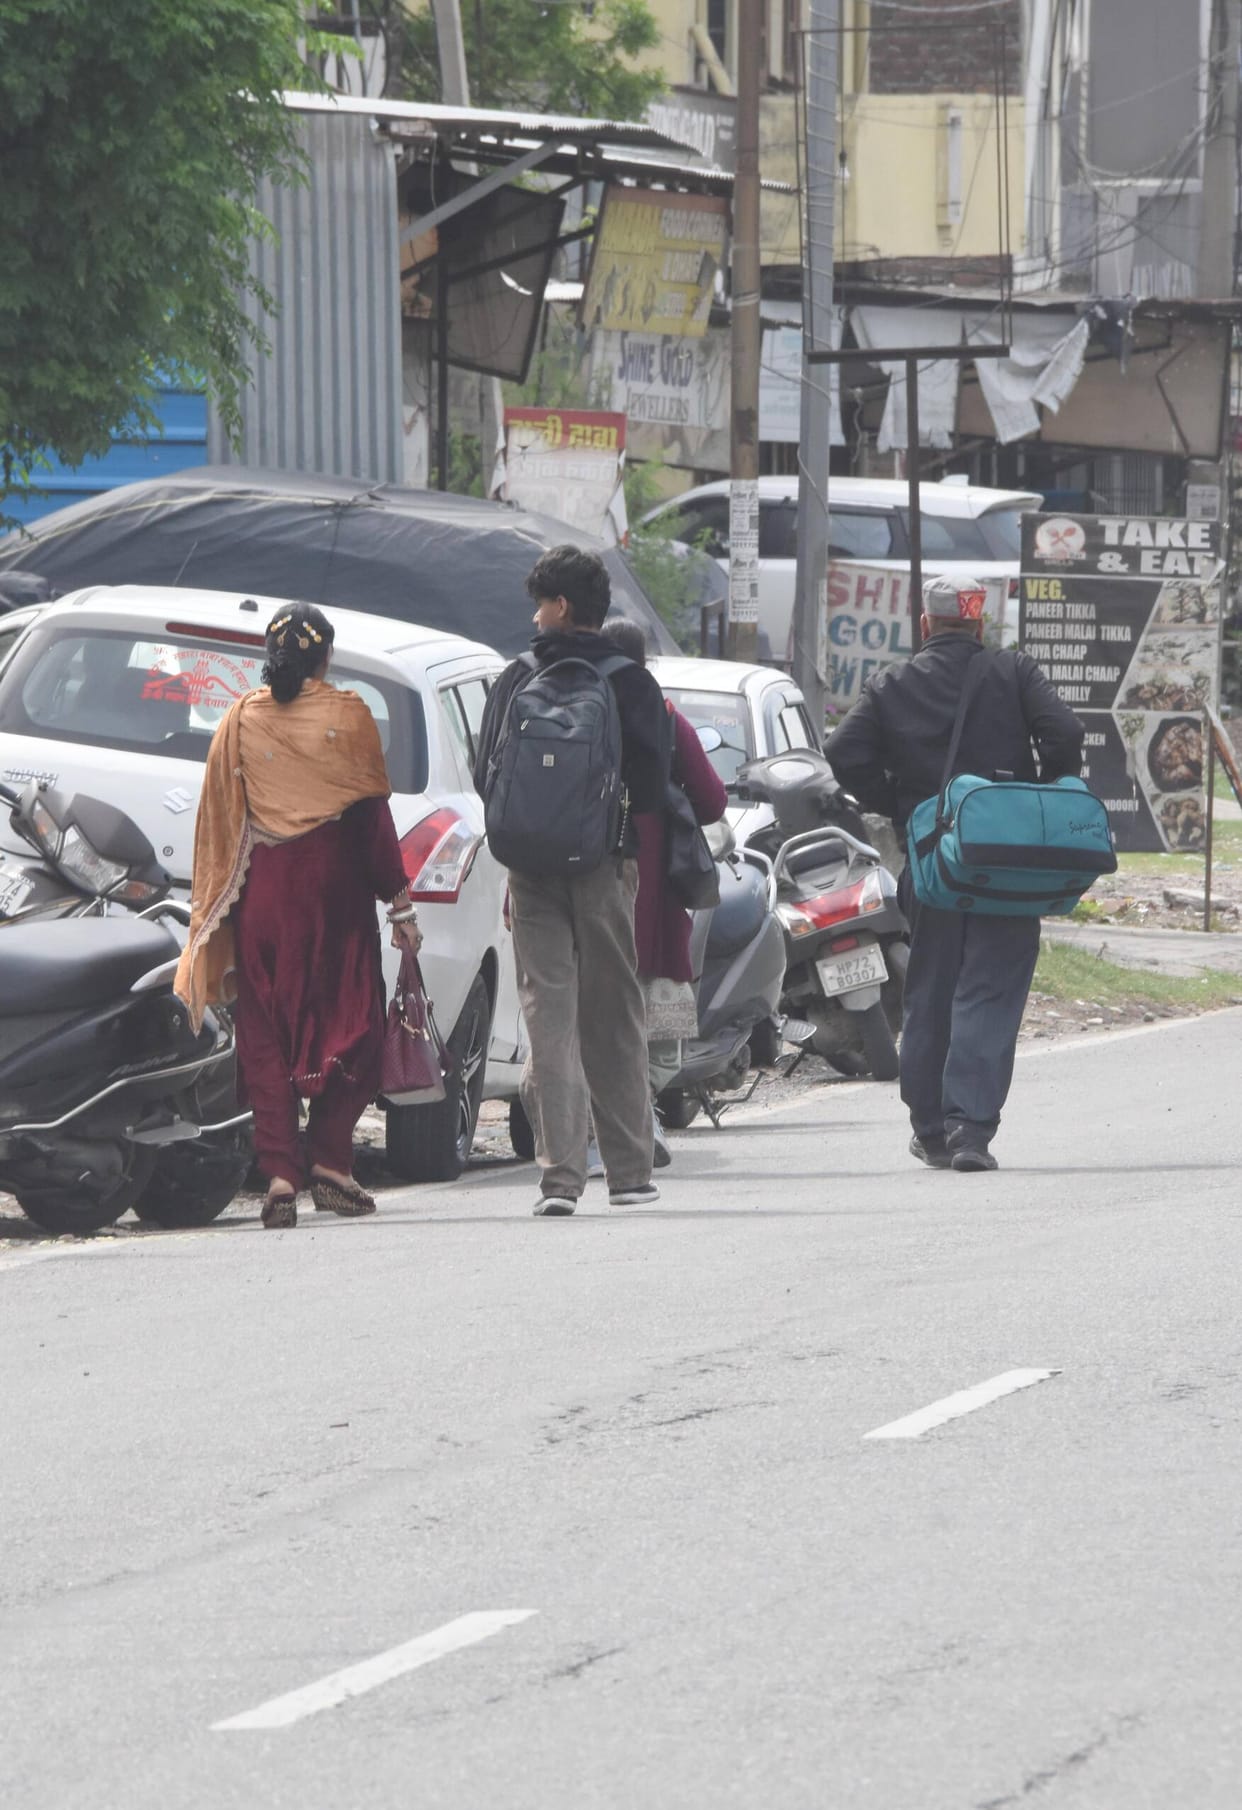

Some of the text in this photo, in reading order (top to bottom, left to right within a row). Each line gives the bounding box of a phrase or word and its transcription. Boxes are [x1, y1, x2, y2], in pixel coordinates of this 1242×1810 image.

[618, 332, 693, 387] SHINE GOLD
[625, 386, 689, 423] JEWELLERS
[1098, 519, 1211, 548] TAKE
[1097, 551, 1128, 572] &
[827, 569, 912, 617] SHI
[1025, 580, 1066, 600] VEG.
[1025, 602, 1096, 620] PANEER TIKKA
[1025, 623, 1131, 642] PANEER MALAI TIKKA
[1052, 645, 1088, 661] CHAAP
[1052, 664, 1084, 681] MALAI
[1085, 666, 1121, 683] CHAAP
[1057, 686, 1091, 702] CHILLY
[836, 956, 870, 975] HP72
[837, 967, 876, 987] B0307
